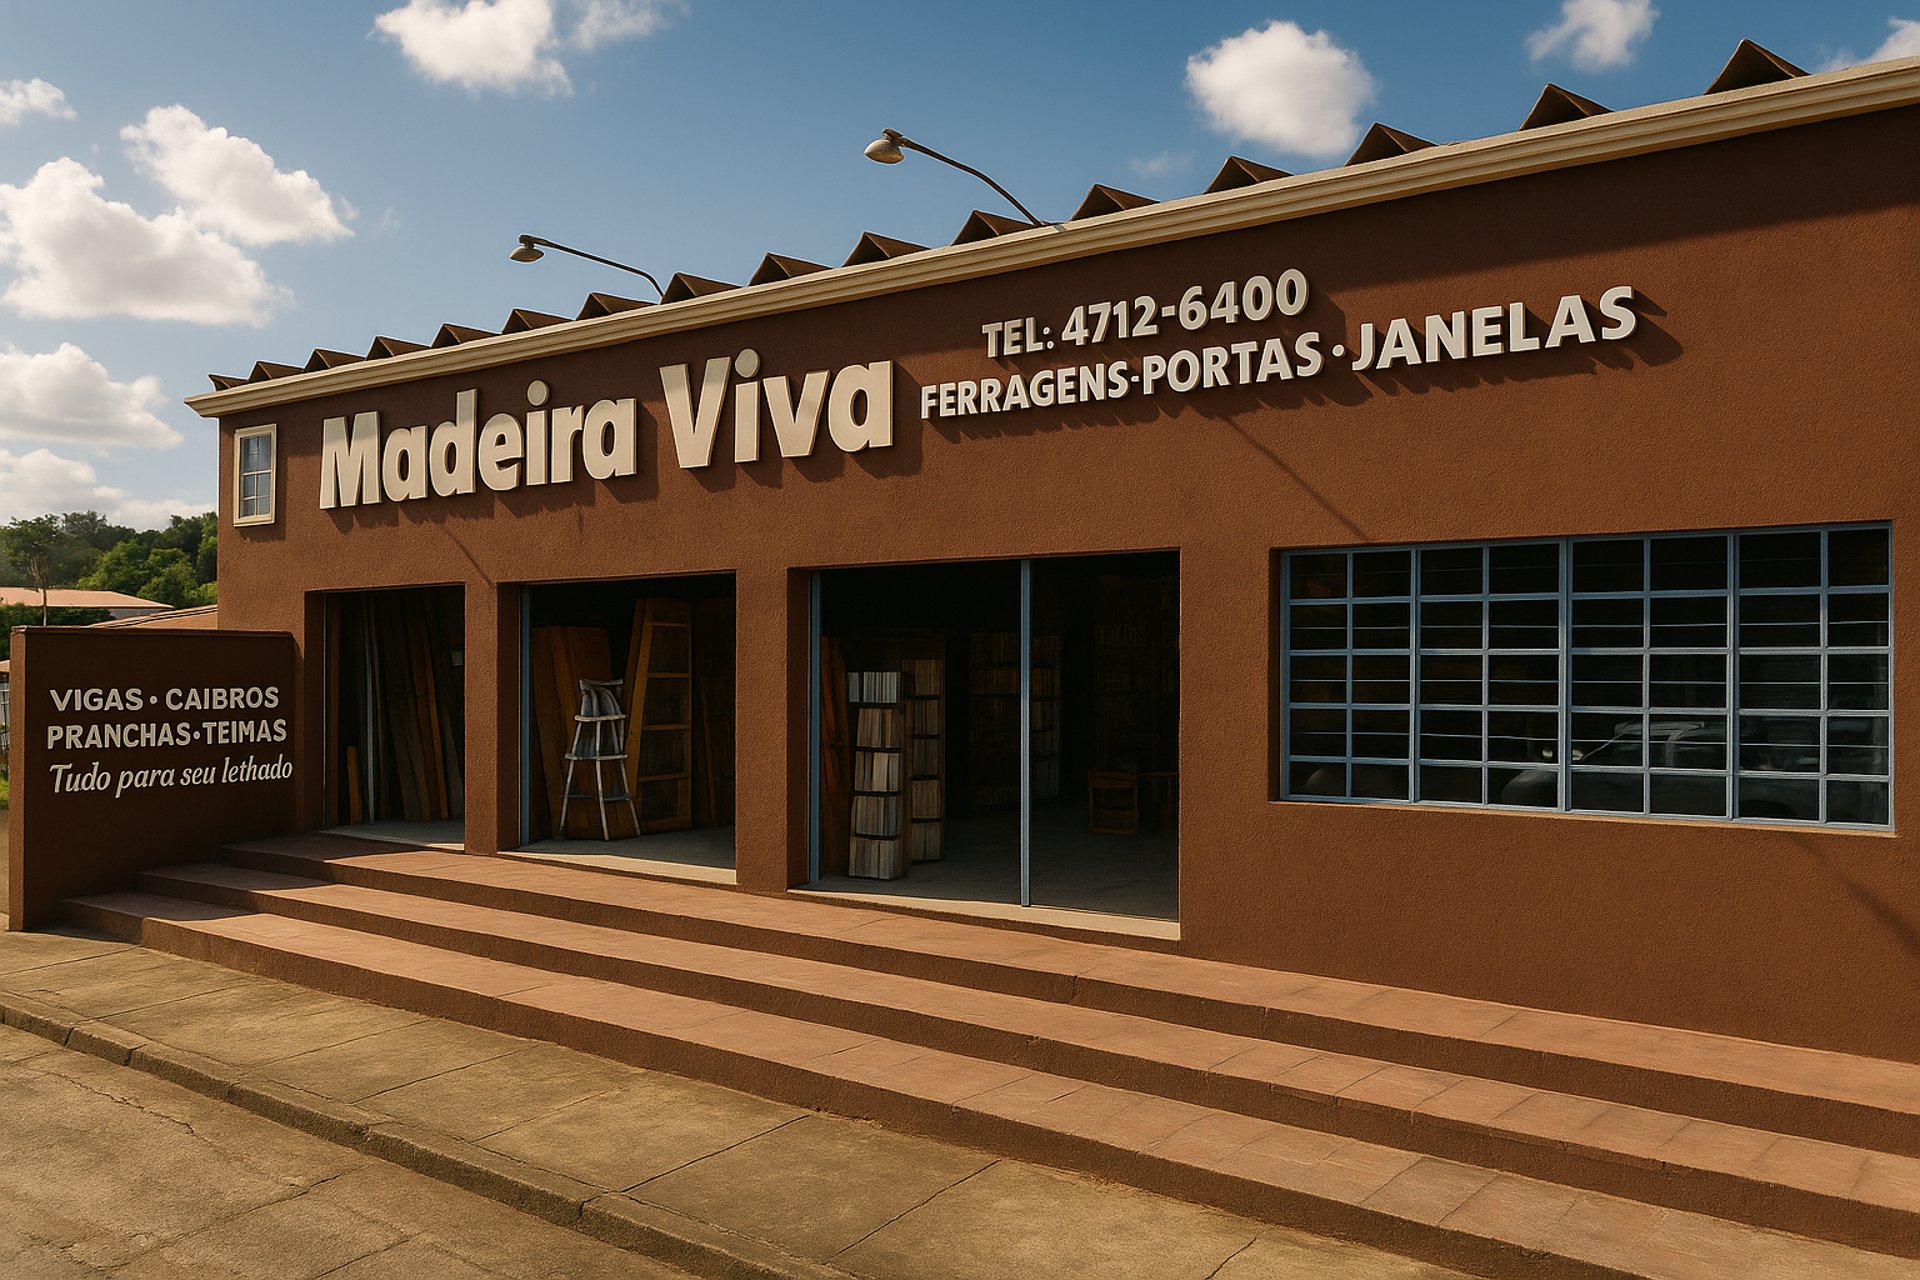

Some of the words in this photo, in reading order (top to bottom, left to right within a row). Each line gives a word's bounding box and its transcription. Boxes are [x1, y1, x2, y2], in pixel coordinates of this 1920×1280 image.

[982, 317, 1055, 358] TEL:
[1061, 268, 1309, 346] 4712-6400
[1351, 285, 1637, 371] JANELAS
[319, 379, 637, 509] Madeira
[659, 348, 894, 469] Viva
[49, 688, 144, 712] VIGAS
[165, 686, 279, 710] CAIBROS
[47, 721, 191, 749] PRANCHAS
[49, 761, 111, 793] Tudo
[114, 766, 175, 798] para
[180, 764, 216, 786] seu
[221, 753, 293, 783] lethado
